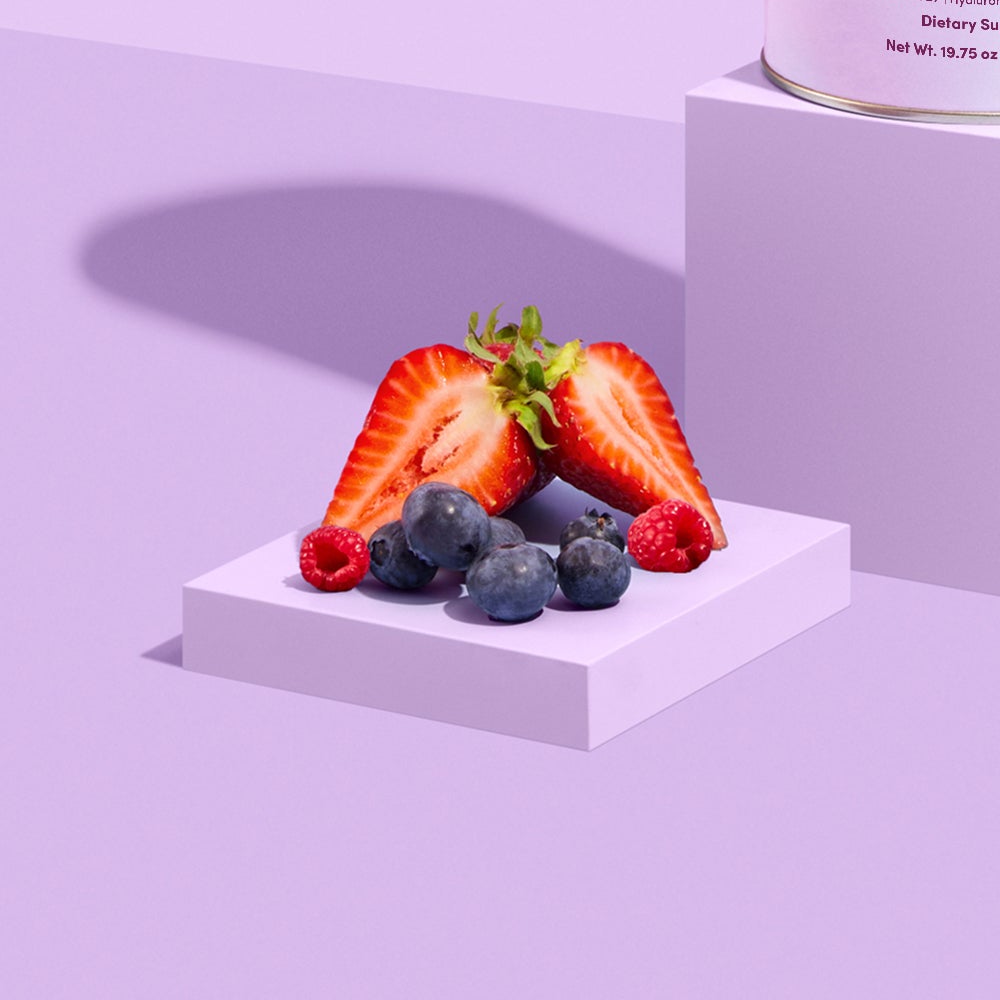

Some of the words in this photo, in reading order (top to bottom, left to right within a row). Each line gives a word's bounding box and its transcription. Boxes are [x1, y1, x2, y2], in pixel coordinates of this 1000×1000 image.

[921, 14, 977, 34] Dietary
[886, 38, 910, 53] Net
[913, 42, 937, 57] Wt.
[940, 46, 978, 60] 19.75
[980, 49, 998, 60] oz
